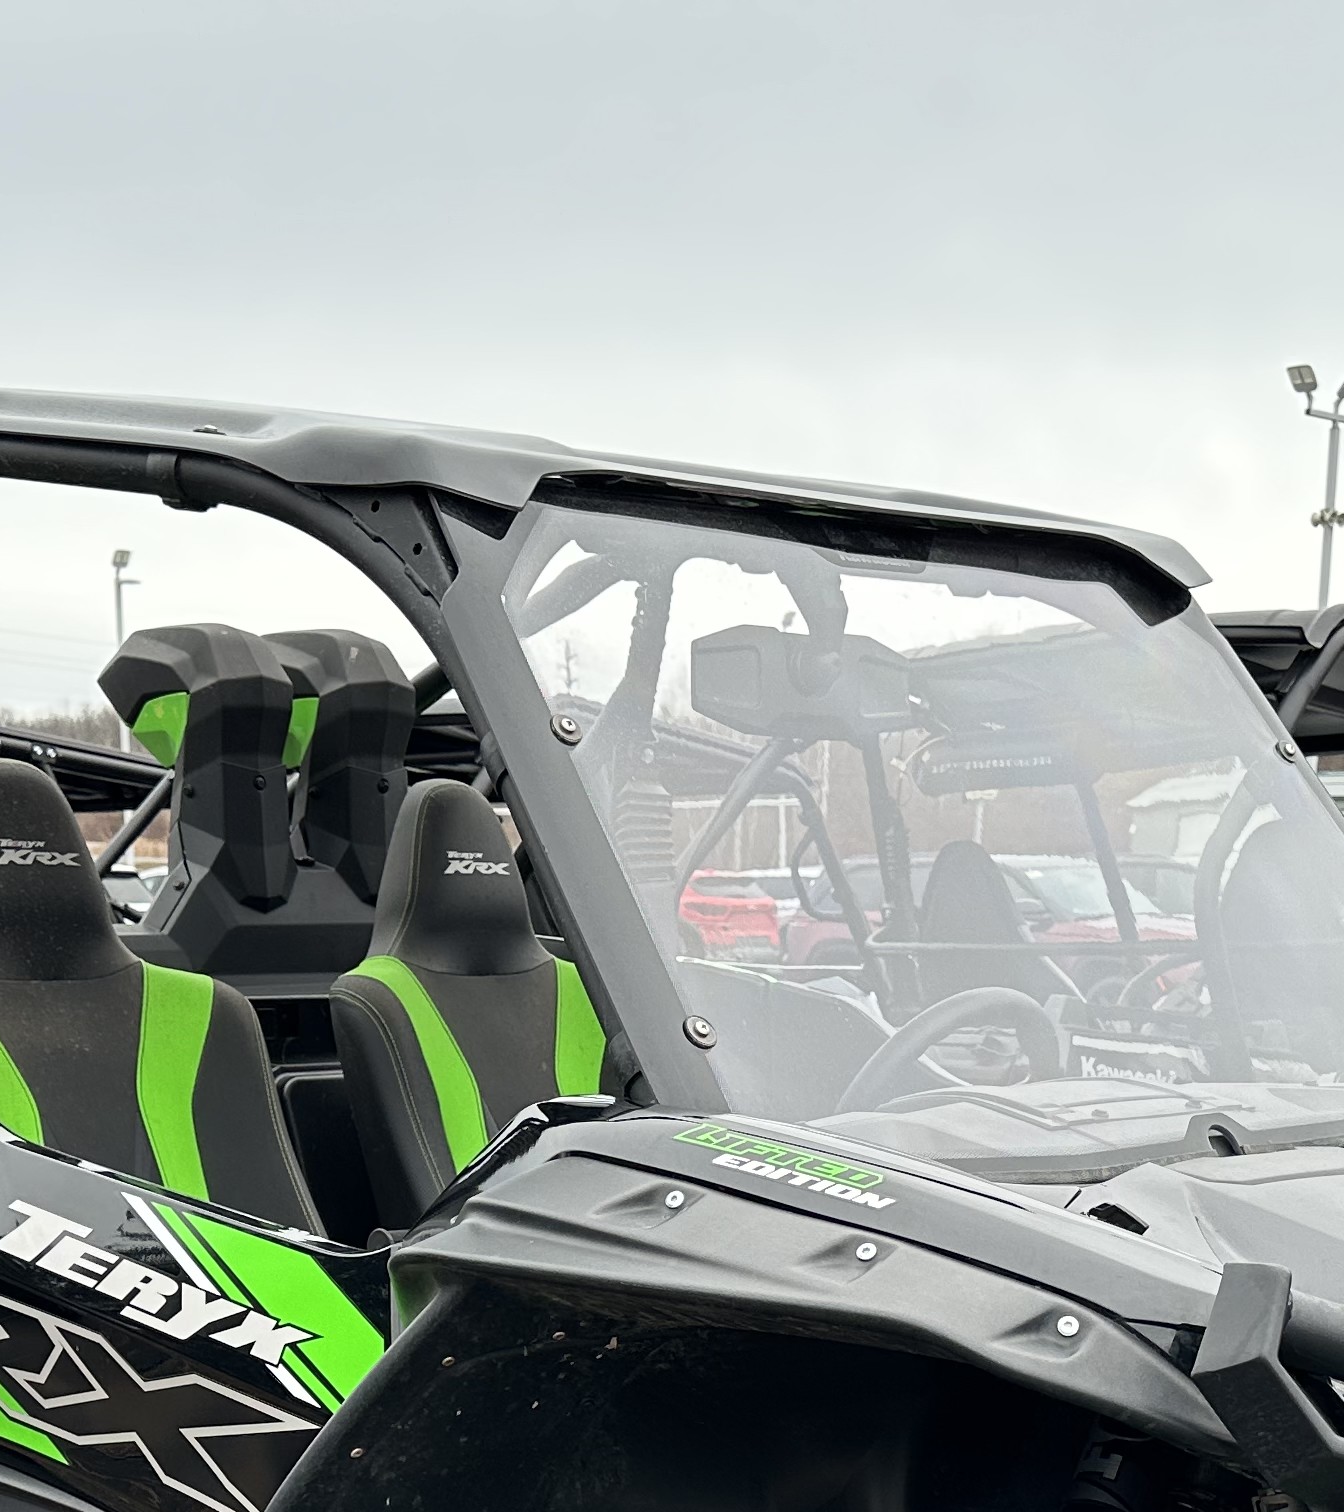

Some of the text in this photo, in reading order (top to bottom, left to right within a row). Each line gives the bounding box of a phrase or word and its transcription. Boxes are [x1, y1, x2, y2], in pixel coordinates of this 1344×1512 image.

[443, 860, 512, 876] KRX
[672, 1122, 885, 1190] LIFTED
[711, 1153, 897, 1210] EDITION
